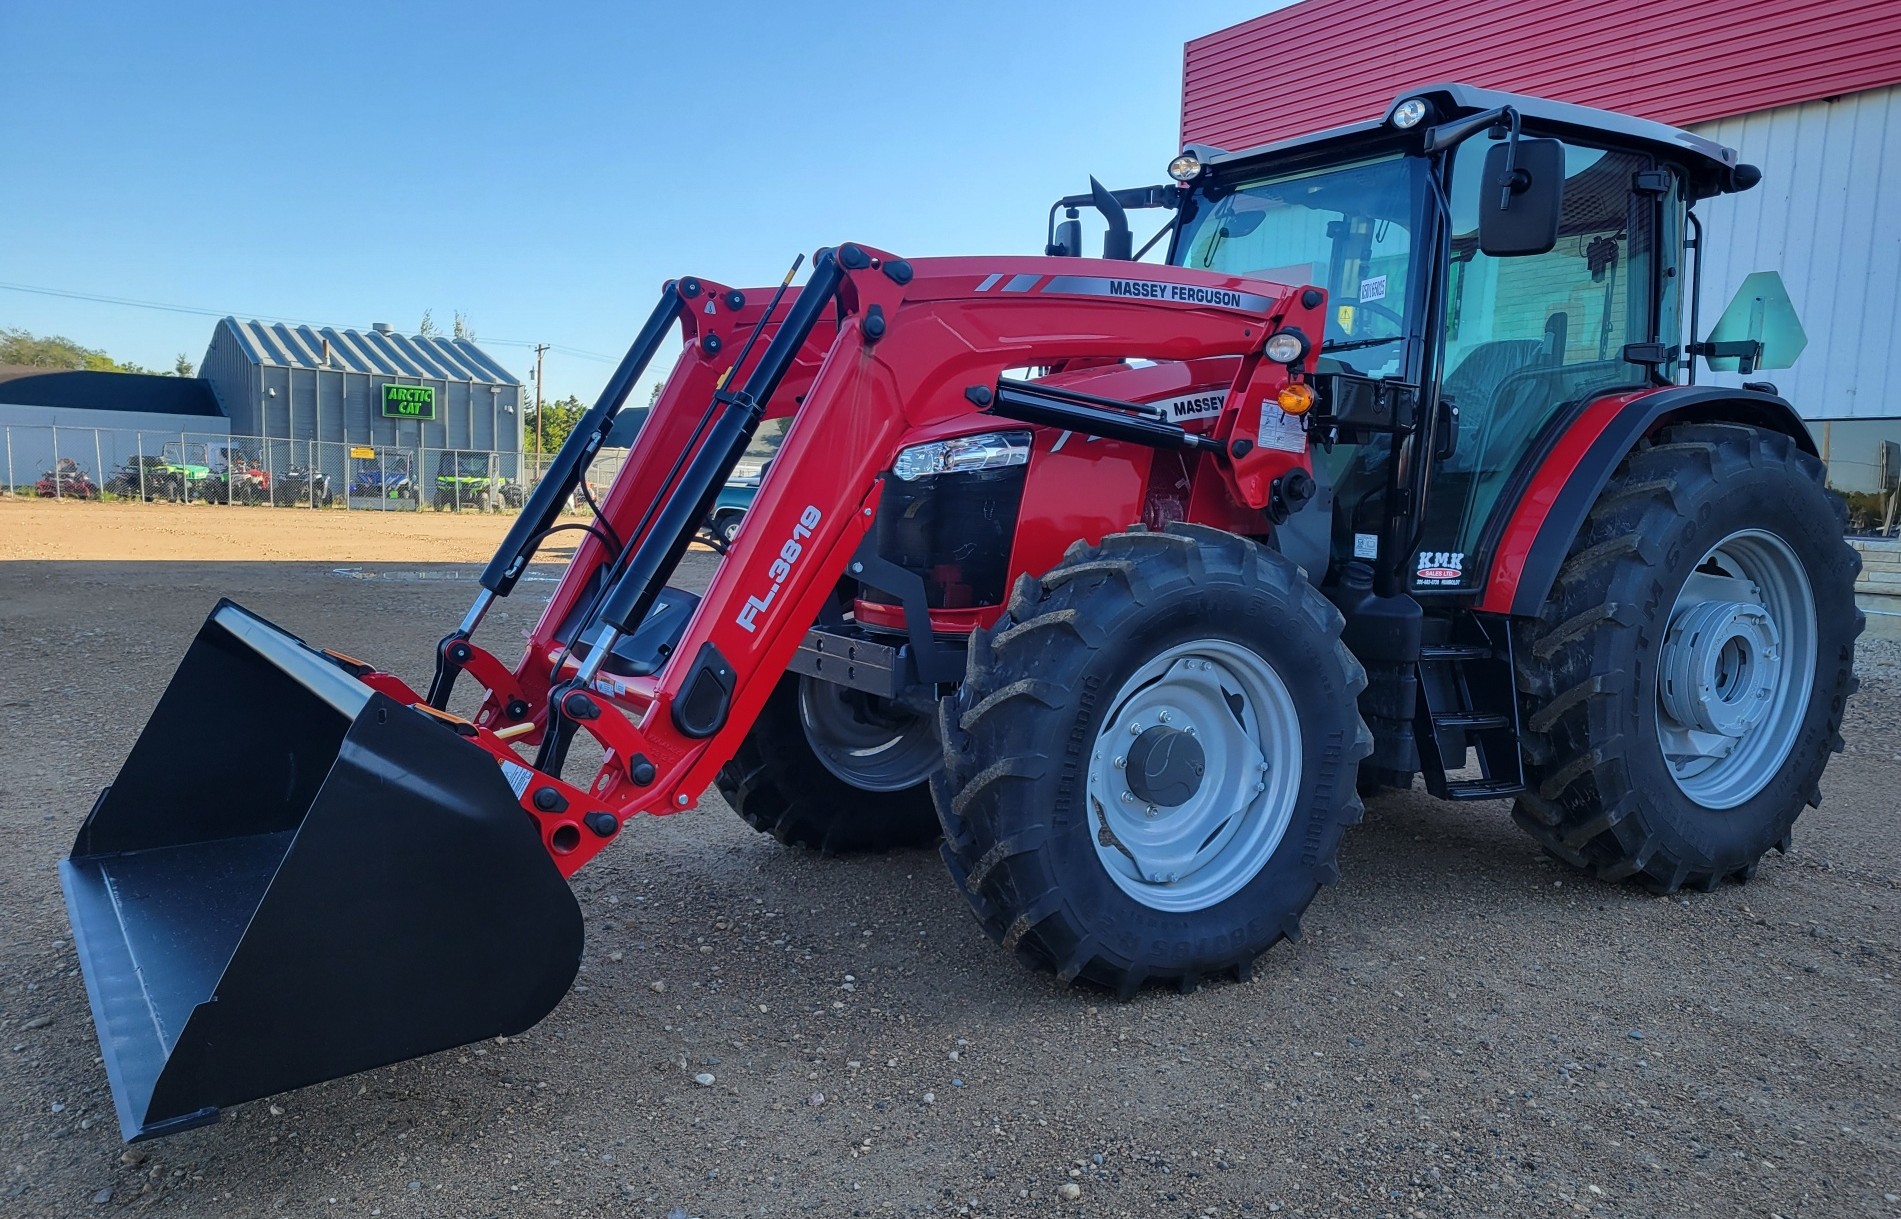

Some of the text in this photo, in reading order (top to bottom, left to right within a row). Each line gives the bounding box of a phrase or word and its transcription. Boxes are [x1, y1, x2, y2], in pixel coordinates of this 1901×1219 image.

[1110, 280, 1240, 307] MASSEY FERGUSON
[388, 388, 431, 402] ARCTIC
[398, 401, 421, 414] CAT
[1173, 396, 1225, 416] MASSEY
[736, 505, 822, 633] FL.3819
